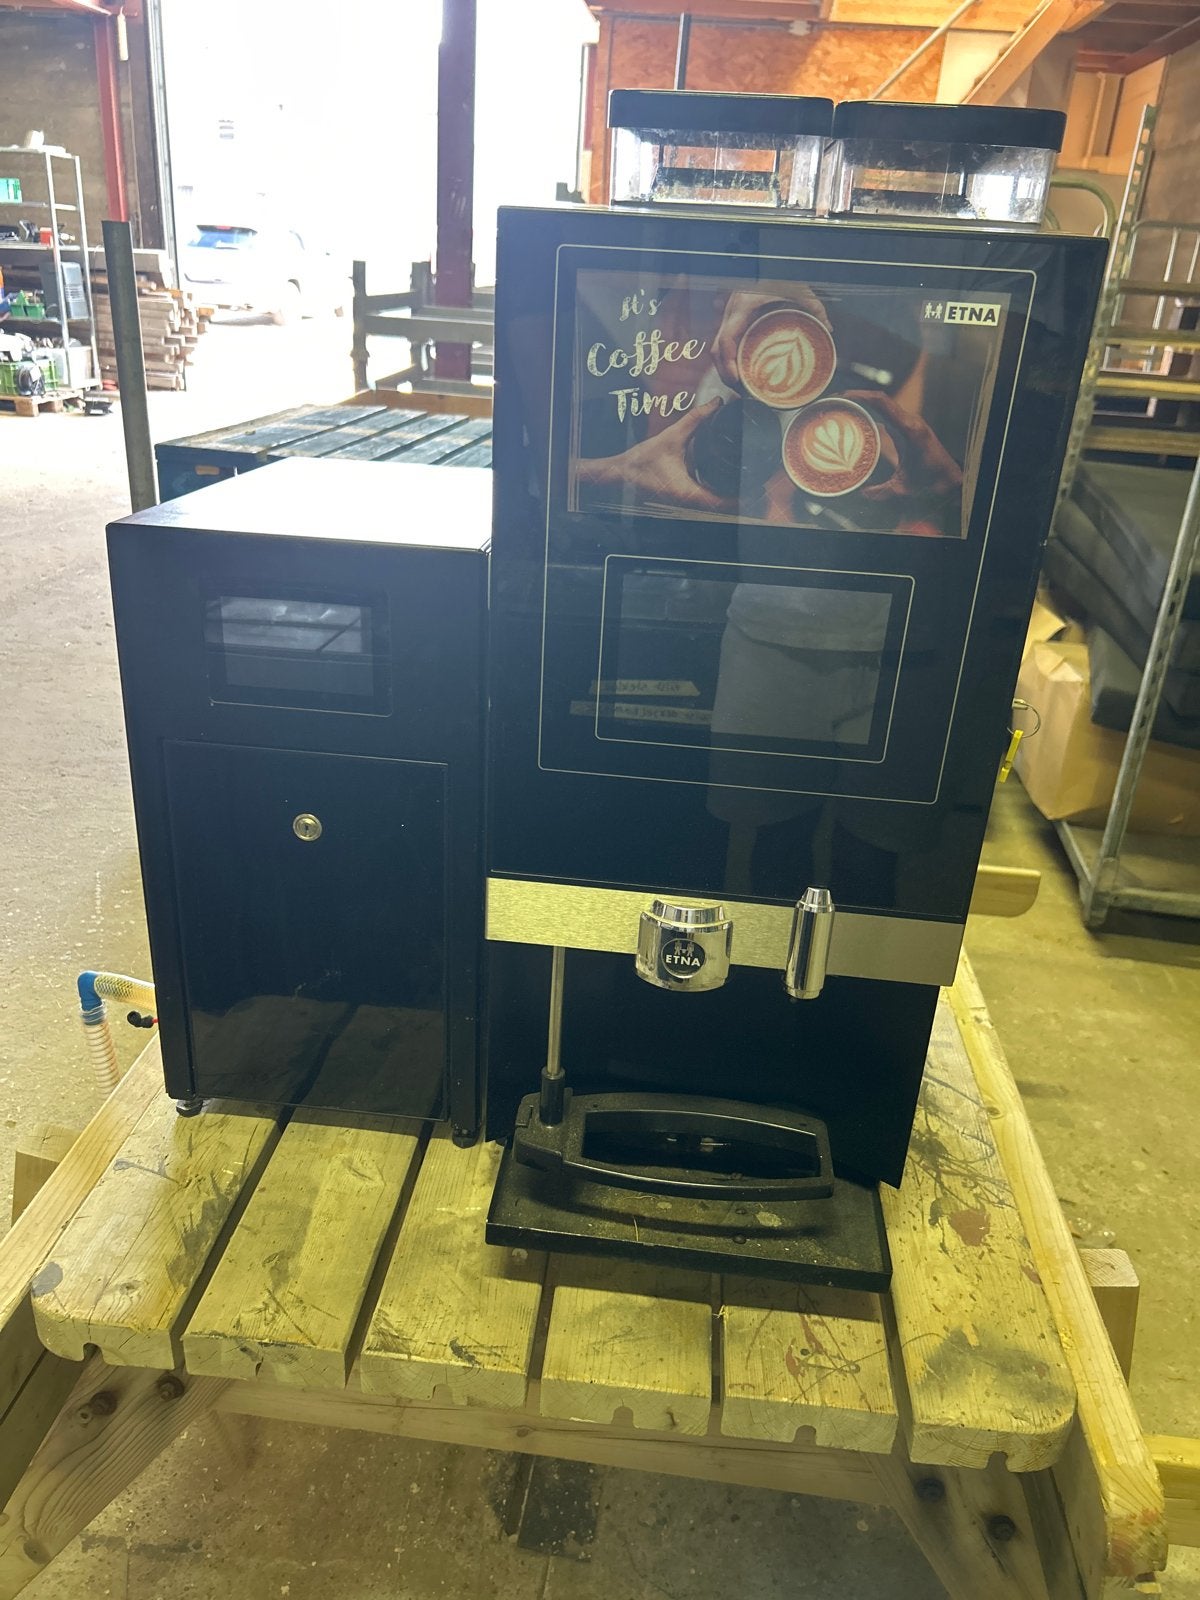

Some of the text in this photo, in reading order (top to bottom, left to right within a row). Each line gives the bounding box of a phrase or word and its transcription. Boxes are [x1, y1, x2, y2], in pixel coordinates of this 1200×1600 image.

[947, 306, 996, 322] ETNA
[587, 329, 706, 377] Coffee
[608, 387, 696, 423] Time
[665, 954, 701, 967] ETNA
